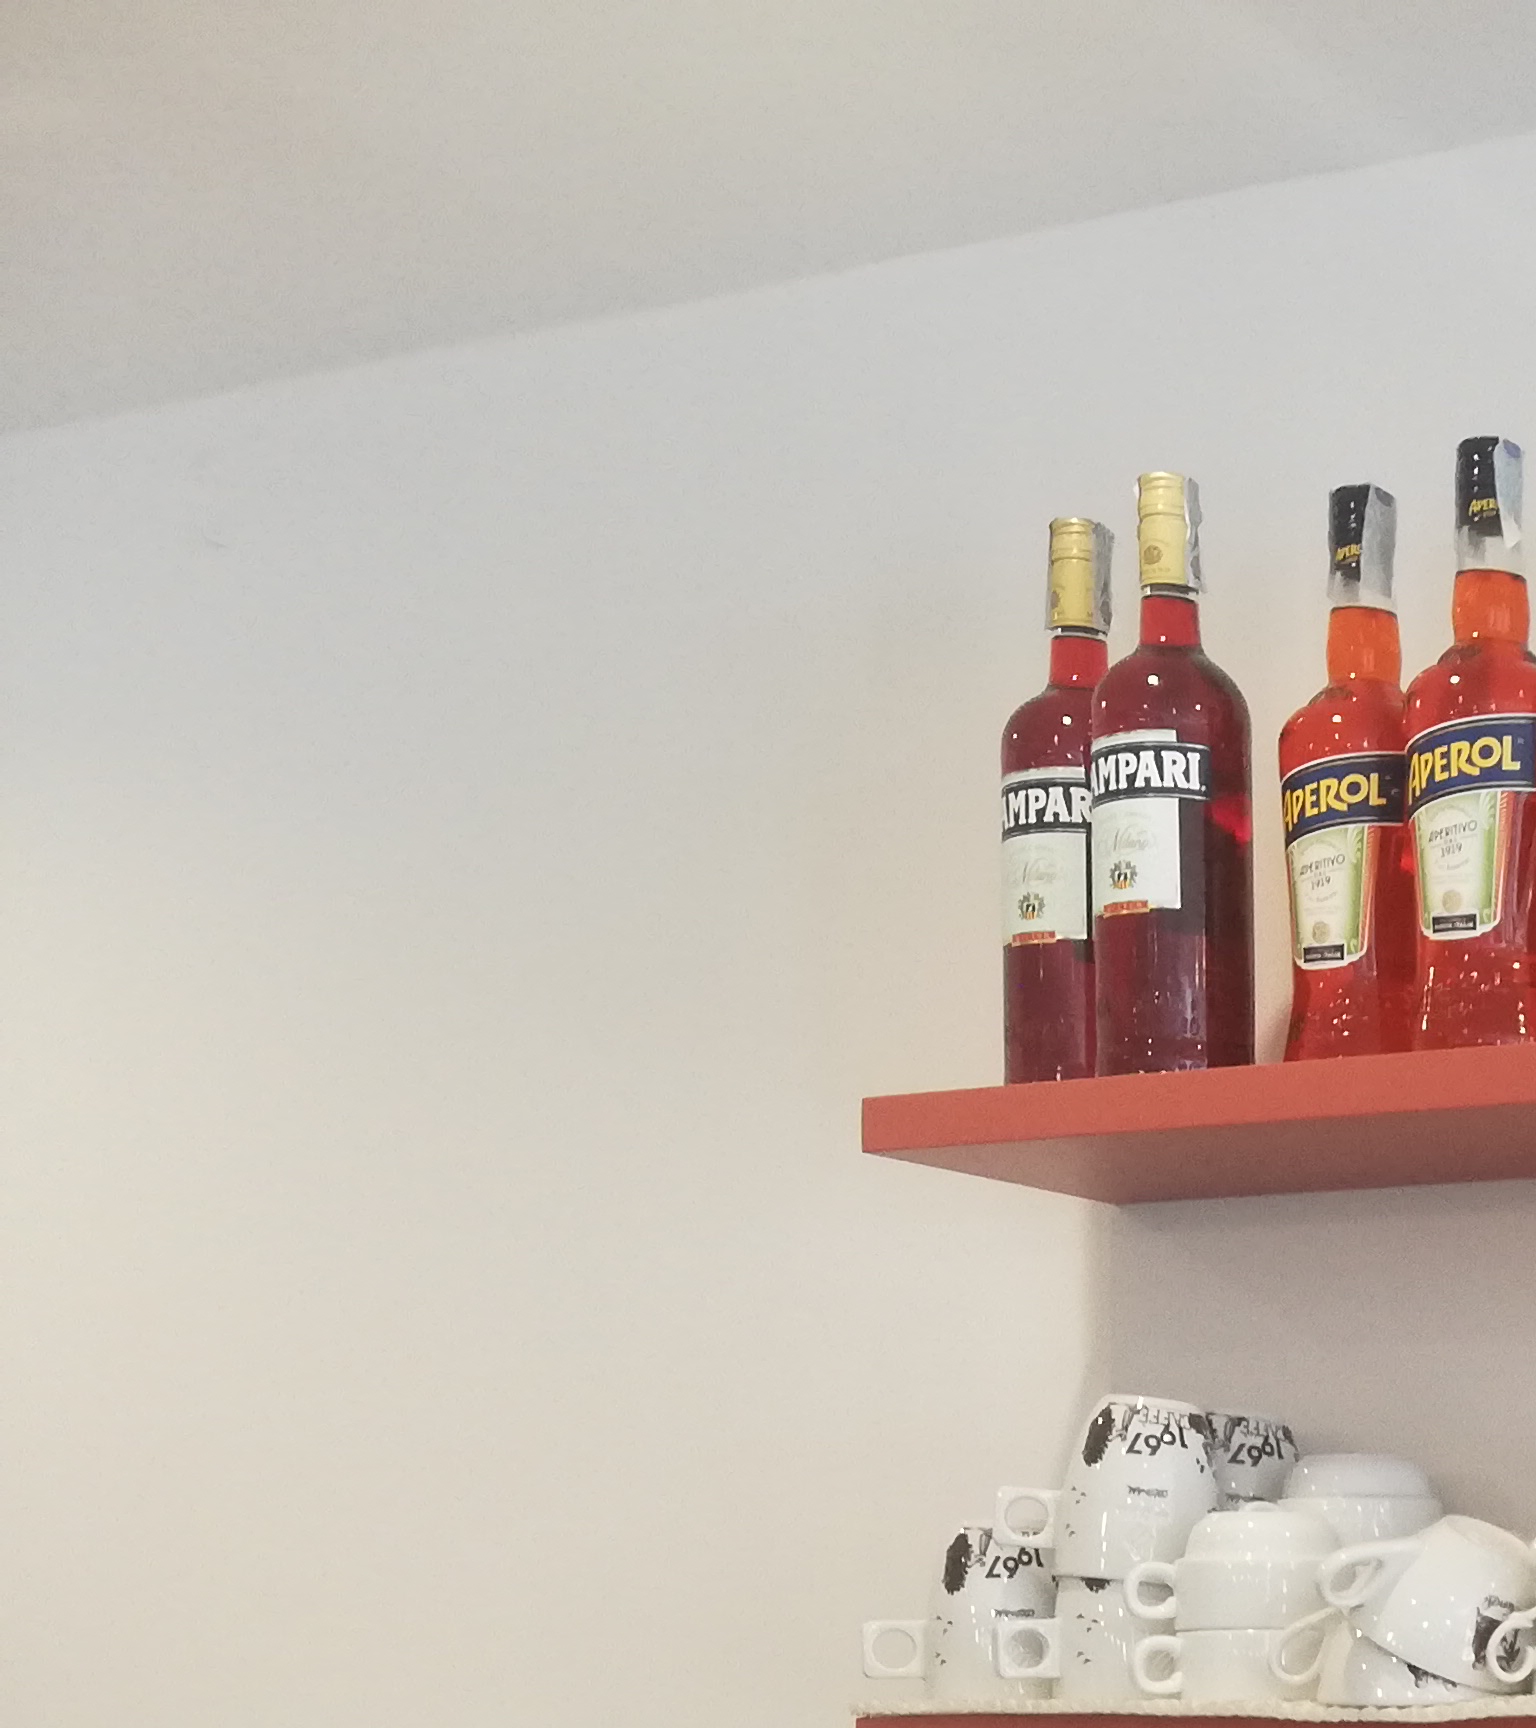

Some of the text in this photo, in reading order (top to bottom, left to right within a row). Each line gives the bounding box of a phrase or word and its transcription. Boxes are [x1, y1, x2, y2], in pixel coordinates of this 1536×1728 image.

[1090, 750, 1201, 797] AMPARI
[1408, 735, 1521, 805] APEROL
[1002, 786, 1092, 830] AMPAR
[1283, 773, 1387, 832] APEROL
[1428, 820, 1477, 843] APERITIVO
[1440, 843, 1463, 858] 1919
[1126, 1424, 1188, 1456] 1967
[1227, 1435, 1284, 1467] 1967
[985, 1547, 1044, 1580] 1967
